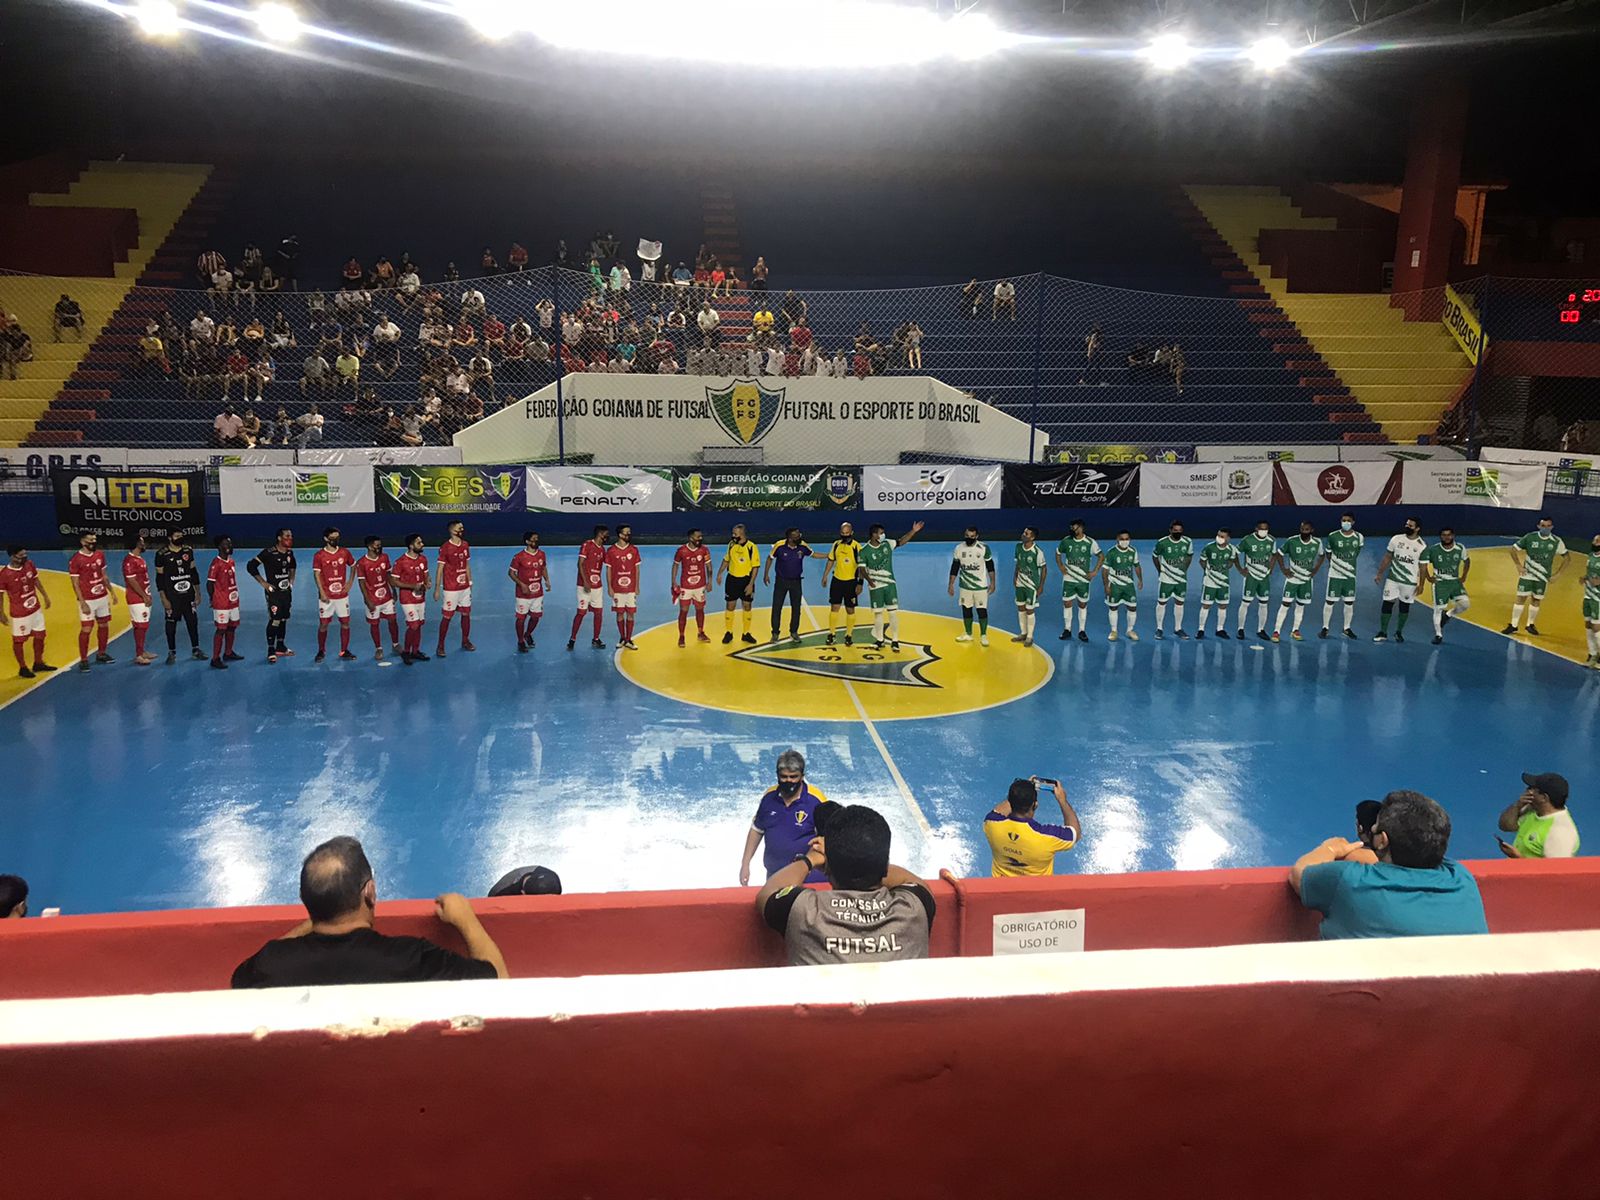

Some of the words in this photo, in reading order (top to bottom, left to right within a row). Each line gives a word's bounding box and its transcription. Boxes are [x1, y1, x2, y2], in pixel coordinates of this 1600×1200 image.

[1450, 304, 1479, 356] BRASIL
[527, 396, 588, 420] FEDERÇÃO
[593, 399, 643, 417] GOIANA
[647, 400, 663, 418] DE
[668, 400, 711, 419] FUTSAL
[784, 401, 836, 420] FUTSAL
[840, 402, 850, 419] O
[854, 401, 914, 420] ESPORTE
[918, 401, 936, 420] DO
[938, 403, 980, 423] BRASIL
[715, 473, 770, 484] FEDERAÇÃO
[771, 474, 806, 482] GOIANA
[1189, 474, 1218, 482] SMESP
[115, 482, 182, 504] TECH
[419, 476, 485, 497] FGFS
[782, 484, 811, 494] SALÃO
[1032, 482, 1110, 495] TOLLEDO
[560, 496, 638, 505] PENALTY
[877, 488, 987, 504] esportegoiano
[84, 507, 183, 522] ELETRÔNICOS
[1001, 919, 1077, 934] OBRIGATÓRIO
[826, 933, 902, 954] FUTSAL
[1019, 938, 1042, 949] USO
[1044, 937, 1059, 947] DE
